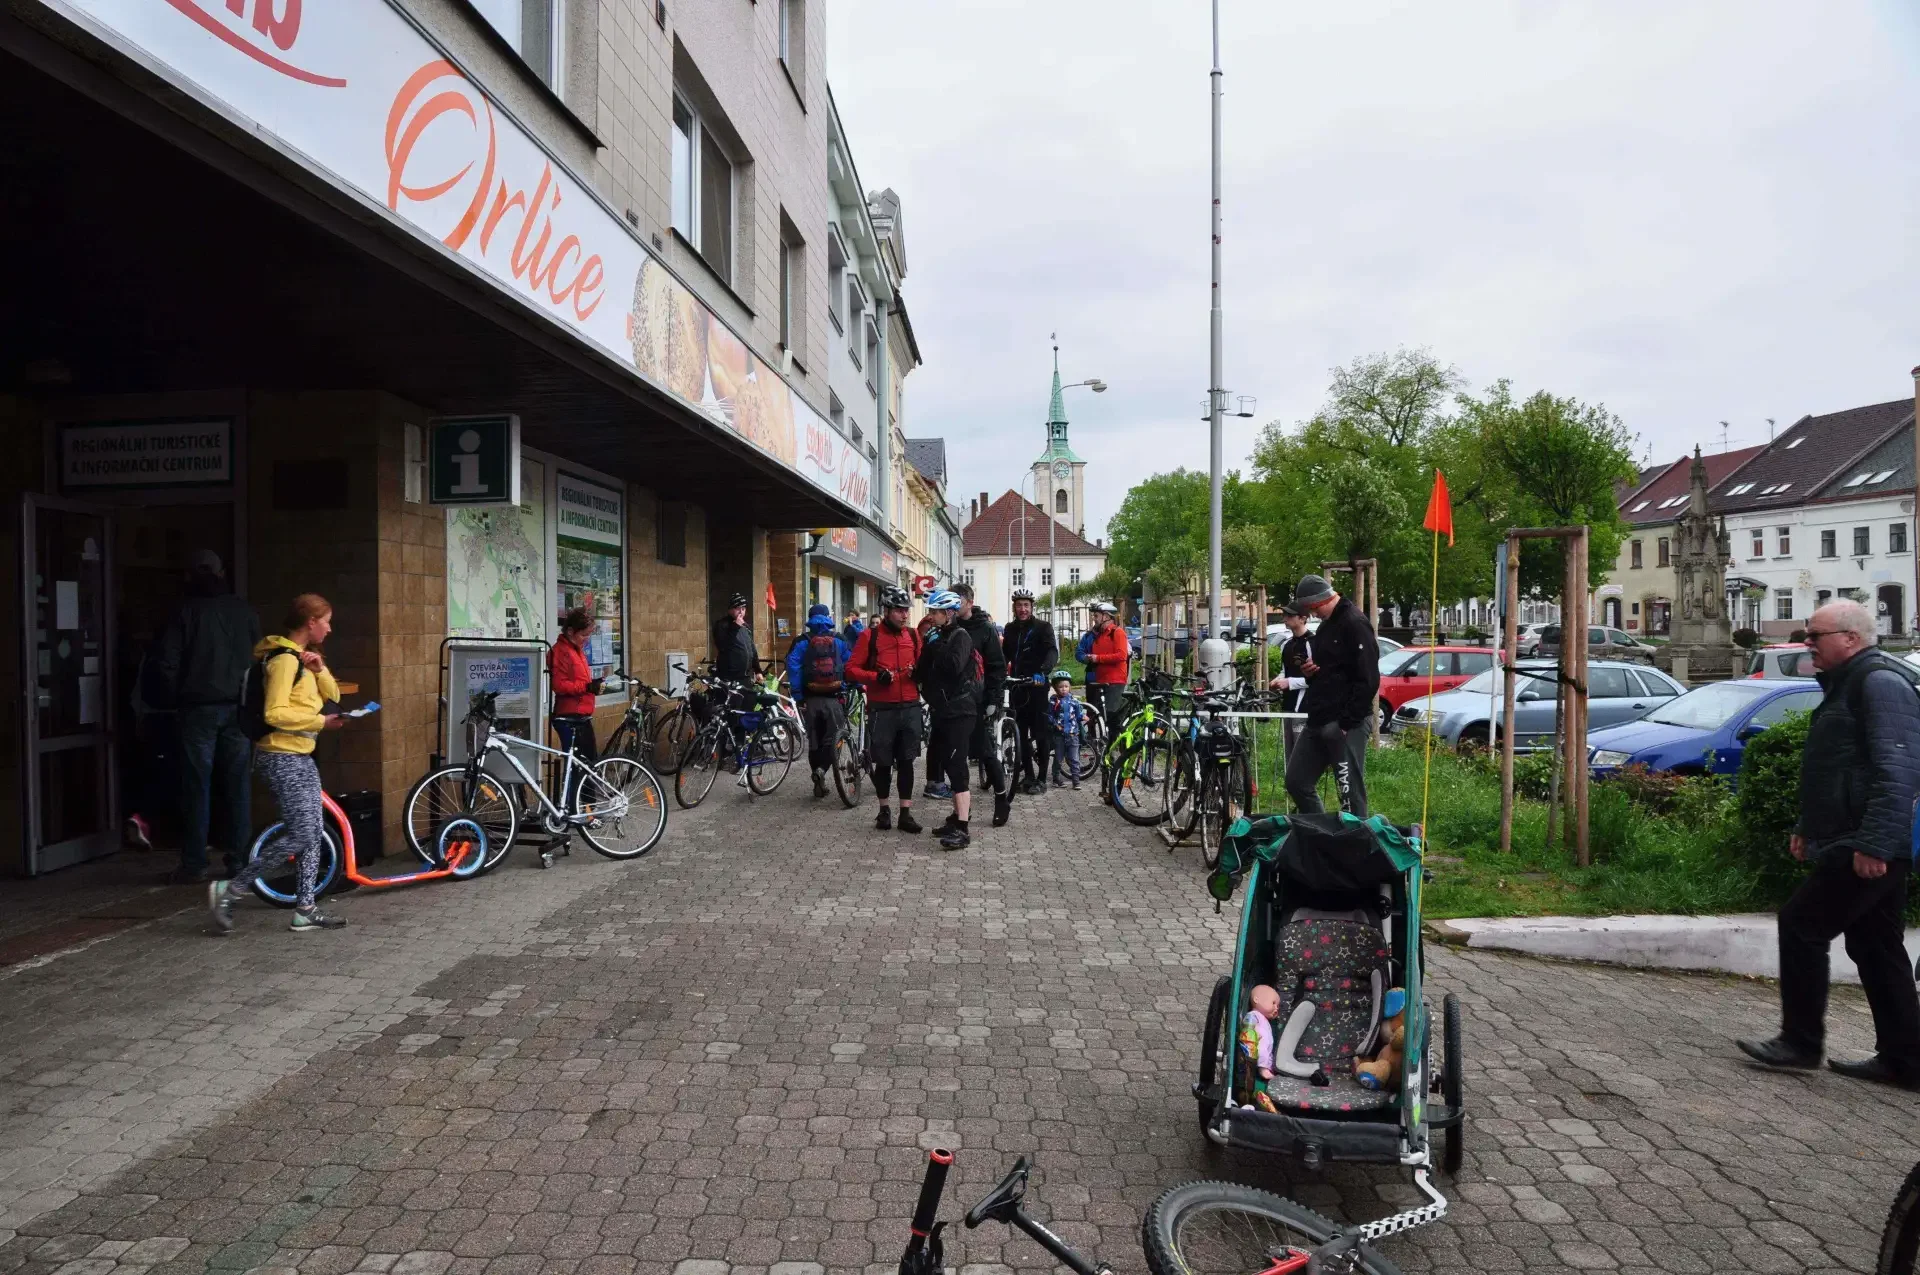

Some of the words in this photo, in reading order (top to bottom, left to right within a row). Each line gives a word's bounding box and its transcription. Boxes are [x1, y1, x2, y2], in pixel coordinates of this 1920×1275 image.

[384, 58, 607, 322] Orlice
[72, 433, 147, 453] REGIONÁLNÍ
[150, 431, 221, 450] TURISTICKÉ
[71, 461, 79, 474] A
[81, 456, 160, 475] INFORMAČNÍ
[163, 454, 223, 472] CENTRUM
[1338, 761, 1350, 794] SAM
